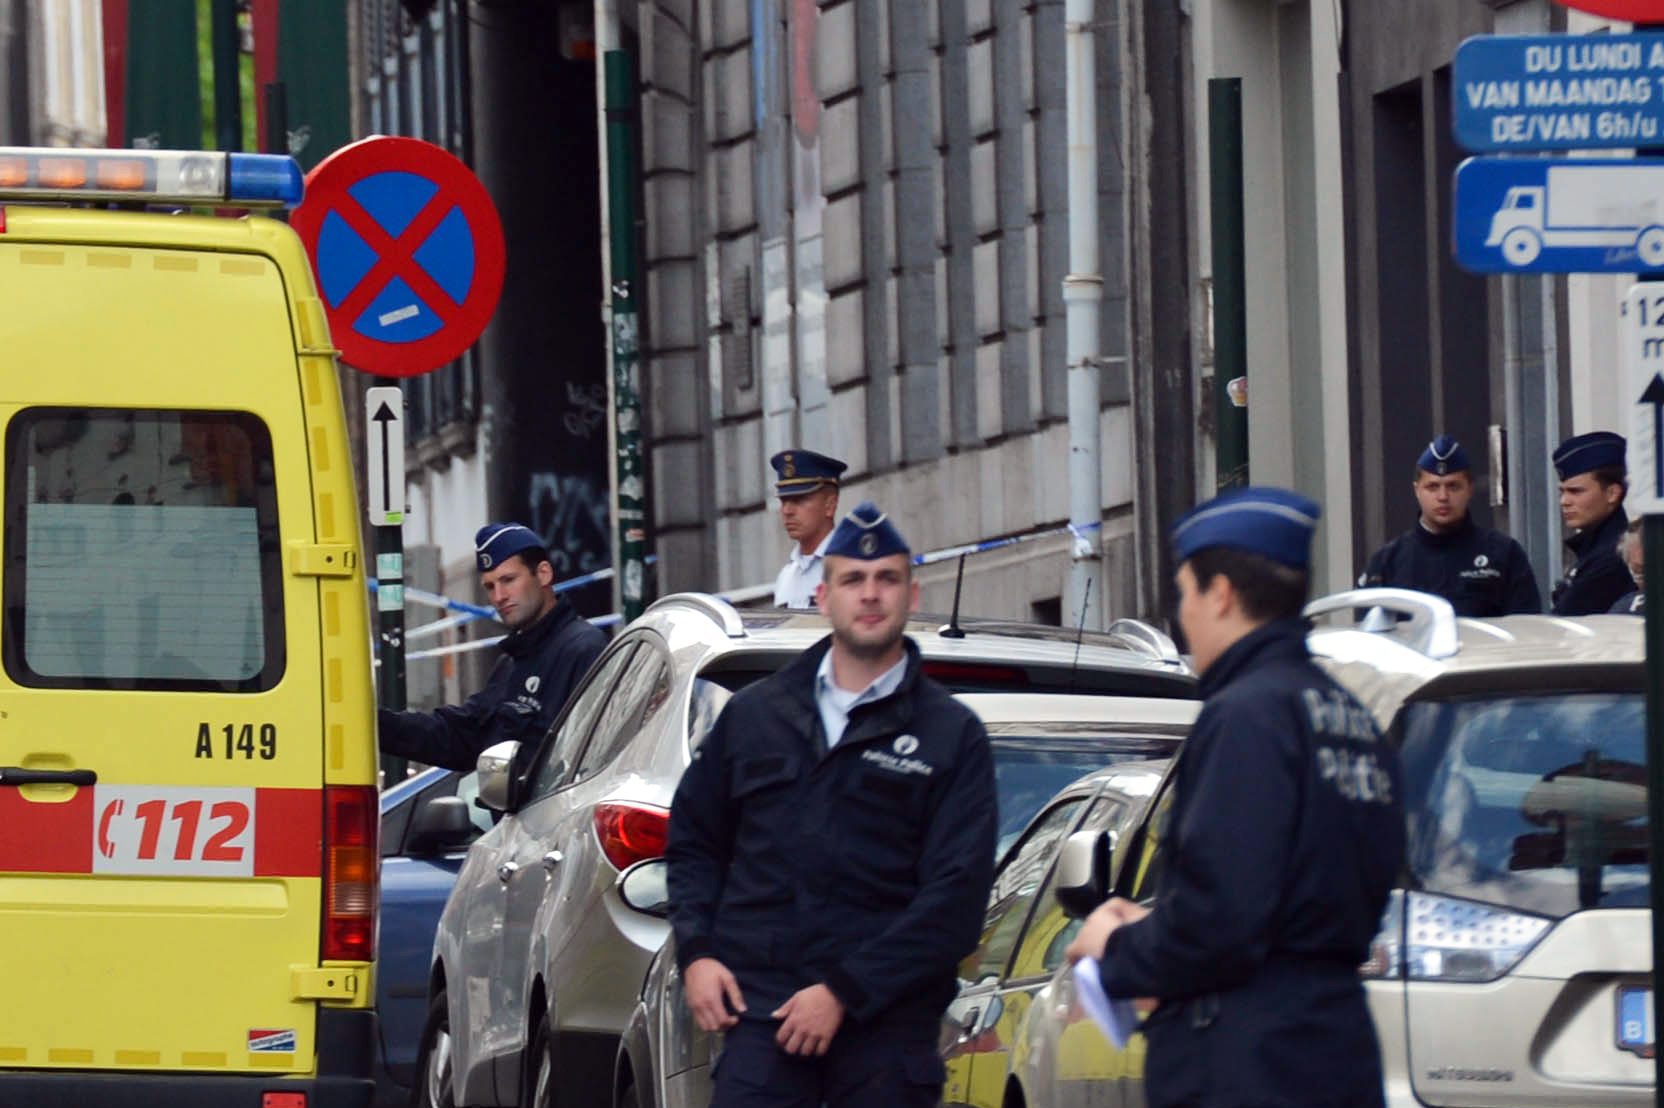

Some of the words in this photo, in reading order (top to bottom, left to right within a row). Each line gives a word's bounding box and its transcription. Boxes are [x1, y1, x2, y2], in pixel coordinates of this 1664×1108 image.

[1525, 44, 1562, 73] DU
[1567, 42, 1642, 71] LUNDI
[1465, 79, 1520, 109] VAN
[1524, 76, 1652, 107] MAANDAG
[1492, 113, 1591, 143] DE/VAN
[195, 722, 213, 759] A
[222, 723, 276, 760] 149
[135, 799, 250, 861] 112
[1624, 1019, 1643, 1040] B
